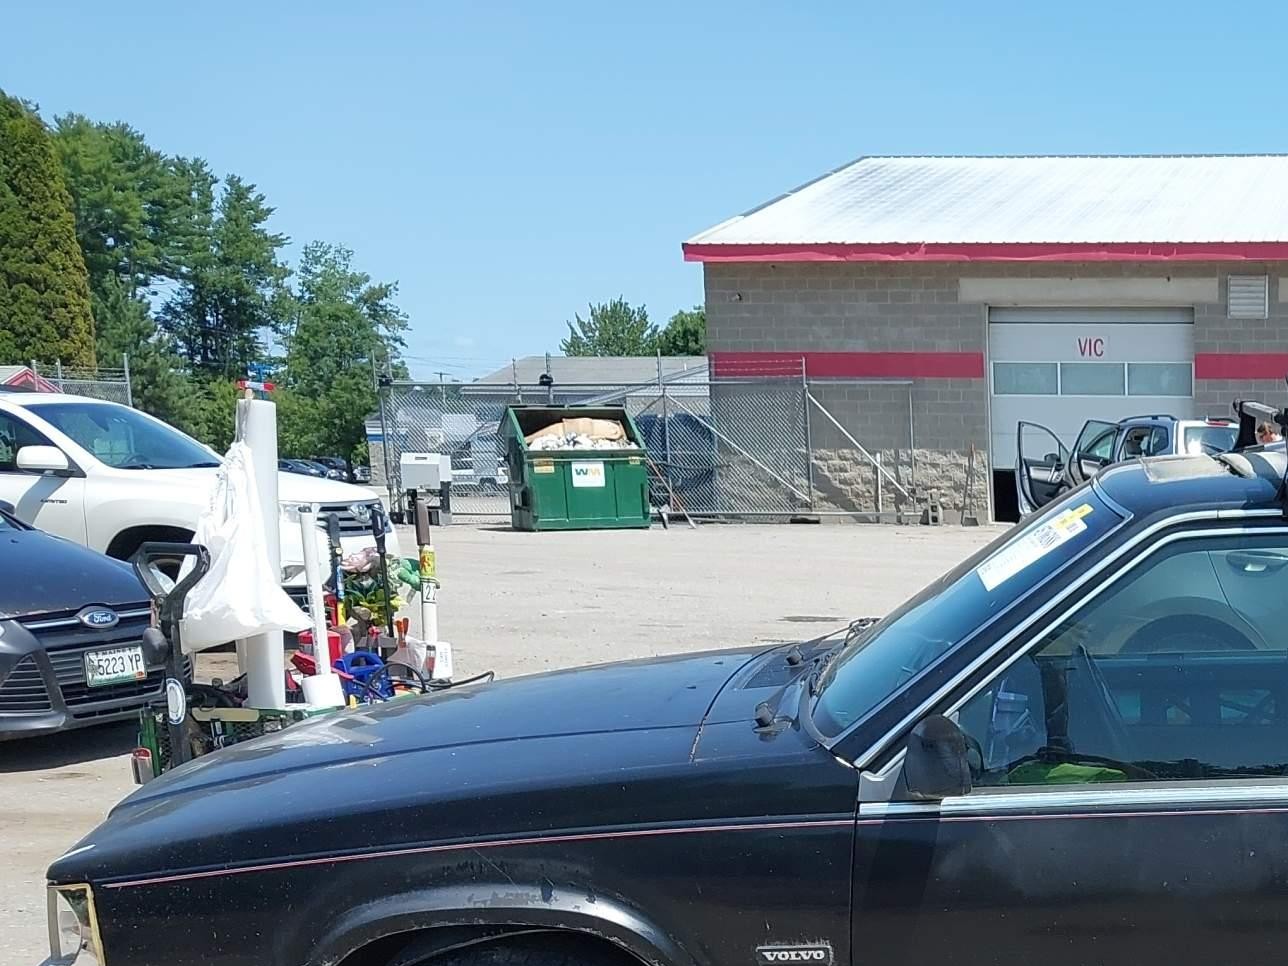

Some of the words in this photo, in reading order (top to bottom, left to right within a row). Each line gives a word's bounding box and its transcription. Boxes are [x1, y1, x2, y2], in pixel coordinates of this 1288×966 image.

[1078, 338, 1104, 357] VIC
[575, 468, 600, 476] WM
[92, 612, 112, 623] Ford
[97, 656, 126, 676] 5223
[128, 653, 141, 672] YP
[762, 950, 825, 961] VOLVO
